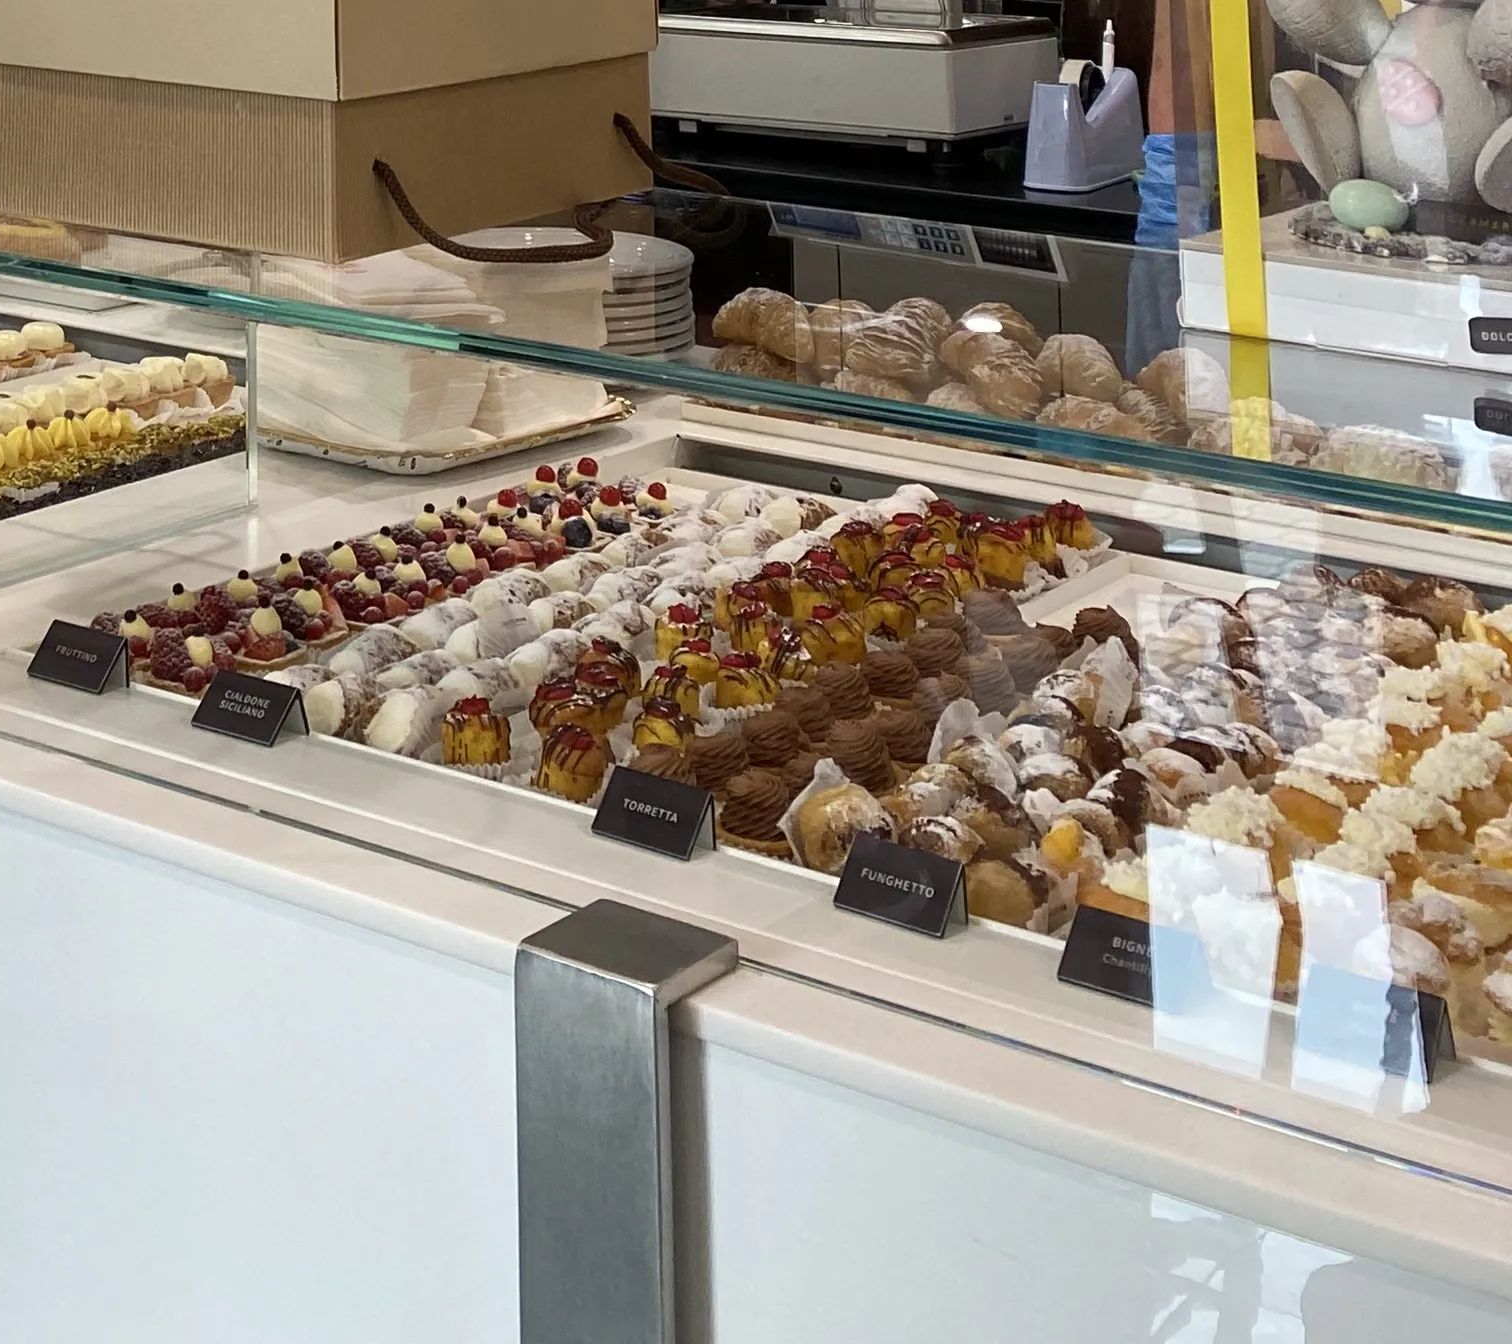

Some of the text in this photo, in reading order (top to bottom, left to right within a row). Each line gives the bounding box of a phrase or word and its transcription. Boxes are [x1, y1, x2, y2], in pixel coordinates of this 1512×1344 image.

[55, 644, 98, 664] FRUTTINO
[219, 699, 265, 719] SICILIANO
[224, 689, 271, 709] CIALDONE
[623, 797, 678, 823] TORRETTA
[860, 867, 935, 898] FUNGHETTO
